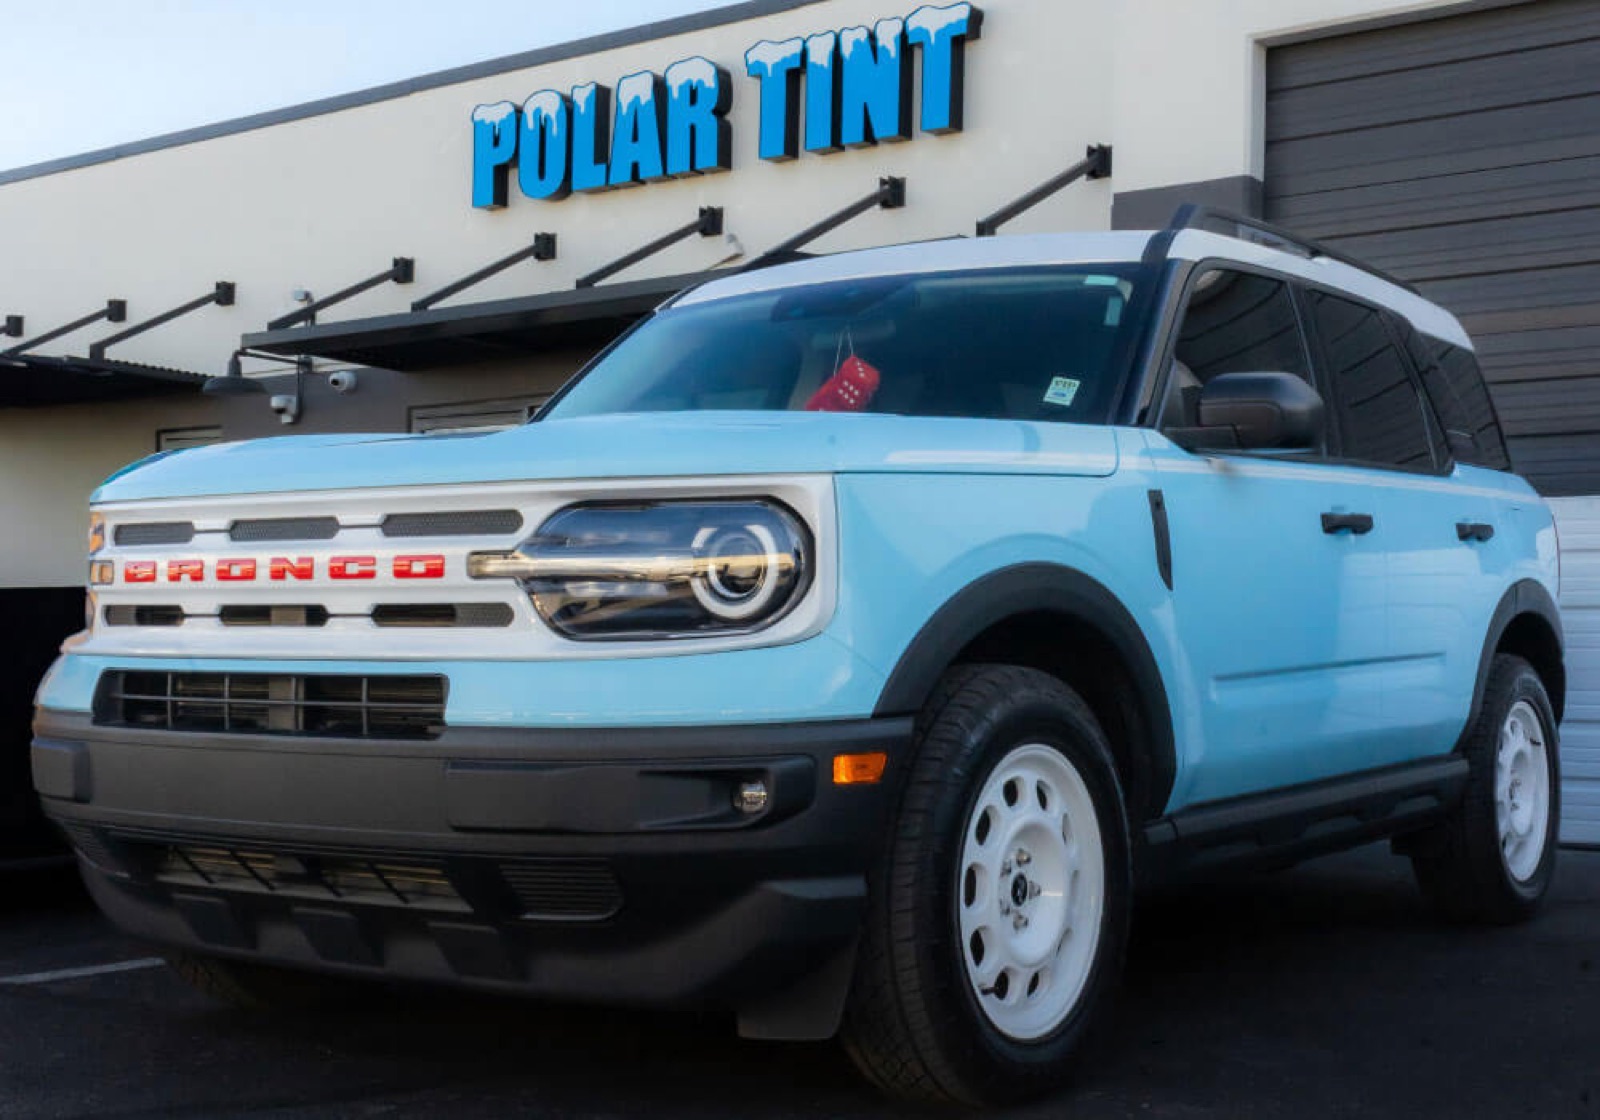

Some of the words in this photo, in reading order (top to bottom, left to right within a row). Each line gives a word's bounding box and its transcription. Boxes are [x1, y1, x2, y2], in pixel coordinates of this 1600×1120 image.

[472, 56, 729, 210] POLAR
[745, 2, 982, 161] TINT
[124, 555, 446, 582] BRONCO
